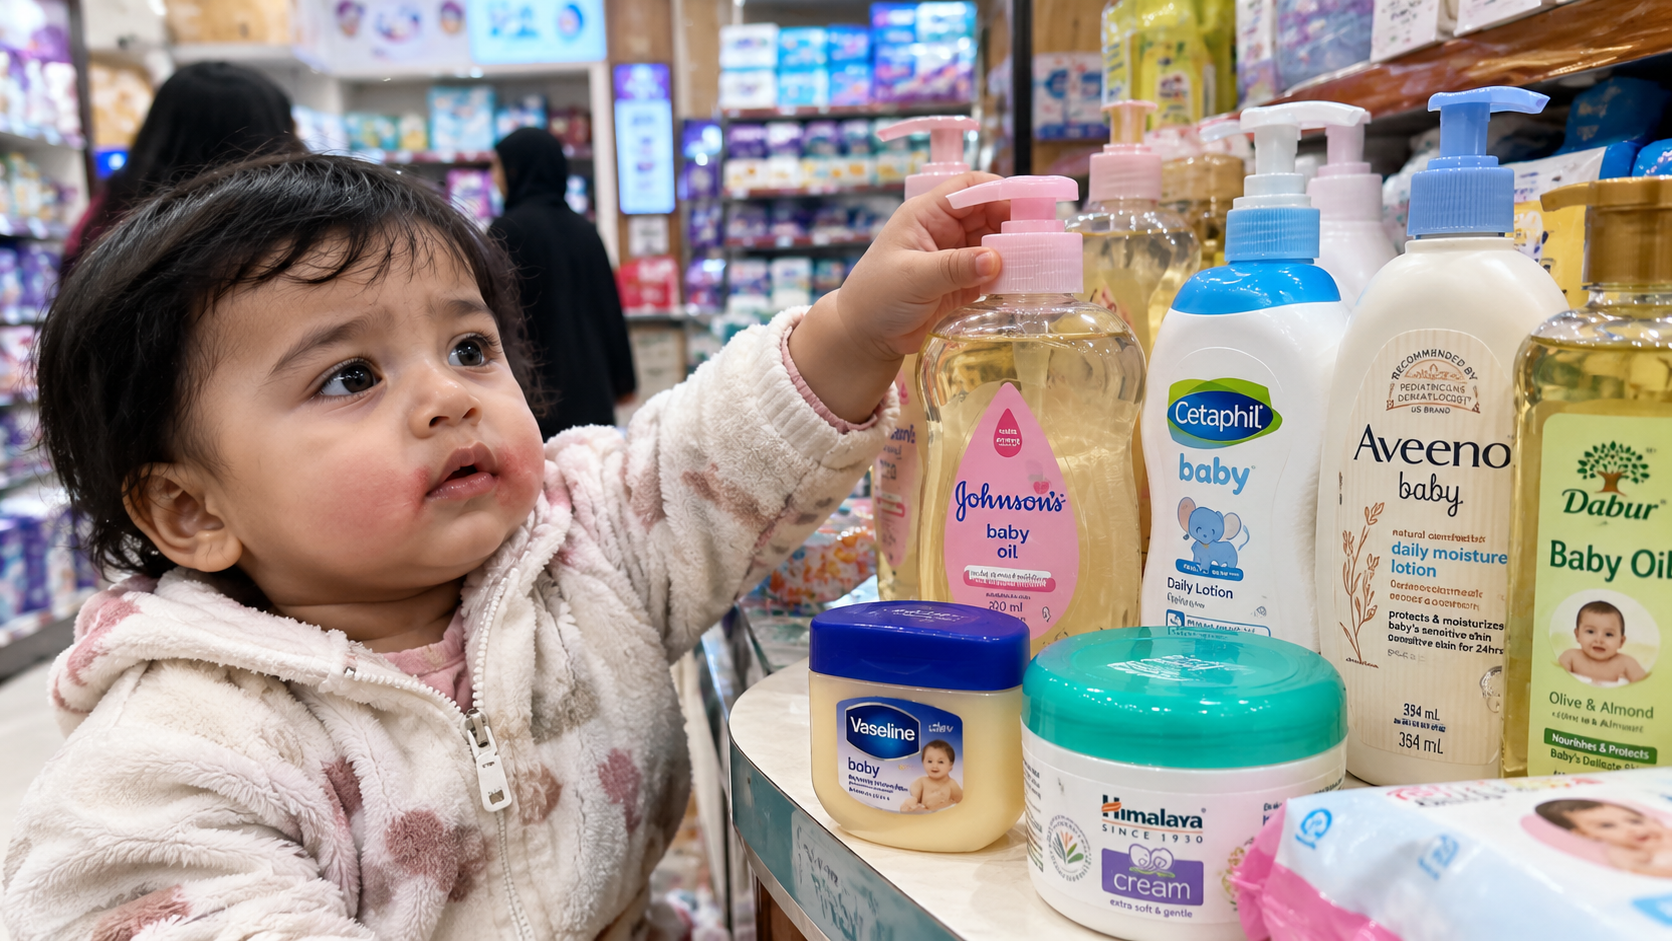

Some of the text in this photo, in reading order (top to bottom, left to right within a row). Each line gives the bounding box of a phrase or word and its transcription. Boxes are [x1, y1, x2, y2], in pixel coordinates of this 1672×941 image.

[1463, 366, 1479, 381] BY
[1175, 401, 1262, 432] Cetaphil
[1353, 424, 1511, 469] Aveeno
[1179, 452, 1251, 495] baby
[955, 480, 1063, 522] Johnson's
[1399, 471, 1464, 517] baby
[1562, 488, 1659, 520] Dabur
[986, 523, 1030, 544] baby
[997, 544, 1018, 559] oil
[1391, 541, 1508, 565] daily moisture
[1550, 539, 1623, 583] Baby
[1391, 559, 1437, 577] lotion
[1167, 577, 1234, 599] Daily Lotion
[1010, 602, 1023, 612] ml
[1389, 610, 1430, 623] protects
[1388, 621, 1420, 634] baby's
[1458, 642, 1474, 652] for
[1424, 708, 1441, 721] mL
[1549, 691, 1654, 719] Olive & Almond
[850, 716, 916, 742] Vaseline
[1550, 748, 1581, 764] Baby's
[1598, 743, 1607, 753] &
[1101, 794, 1203, 829] Himalaya
[1102, 823, 1203, 844] SINCE 1930
[1113, 873, 1190, 899] cream
[1110, 899, 1132, 910] extra
[1135, 904, 1153, 914] soft
[1163, 909, 1193, 918] gentle
